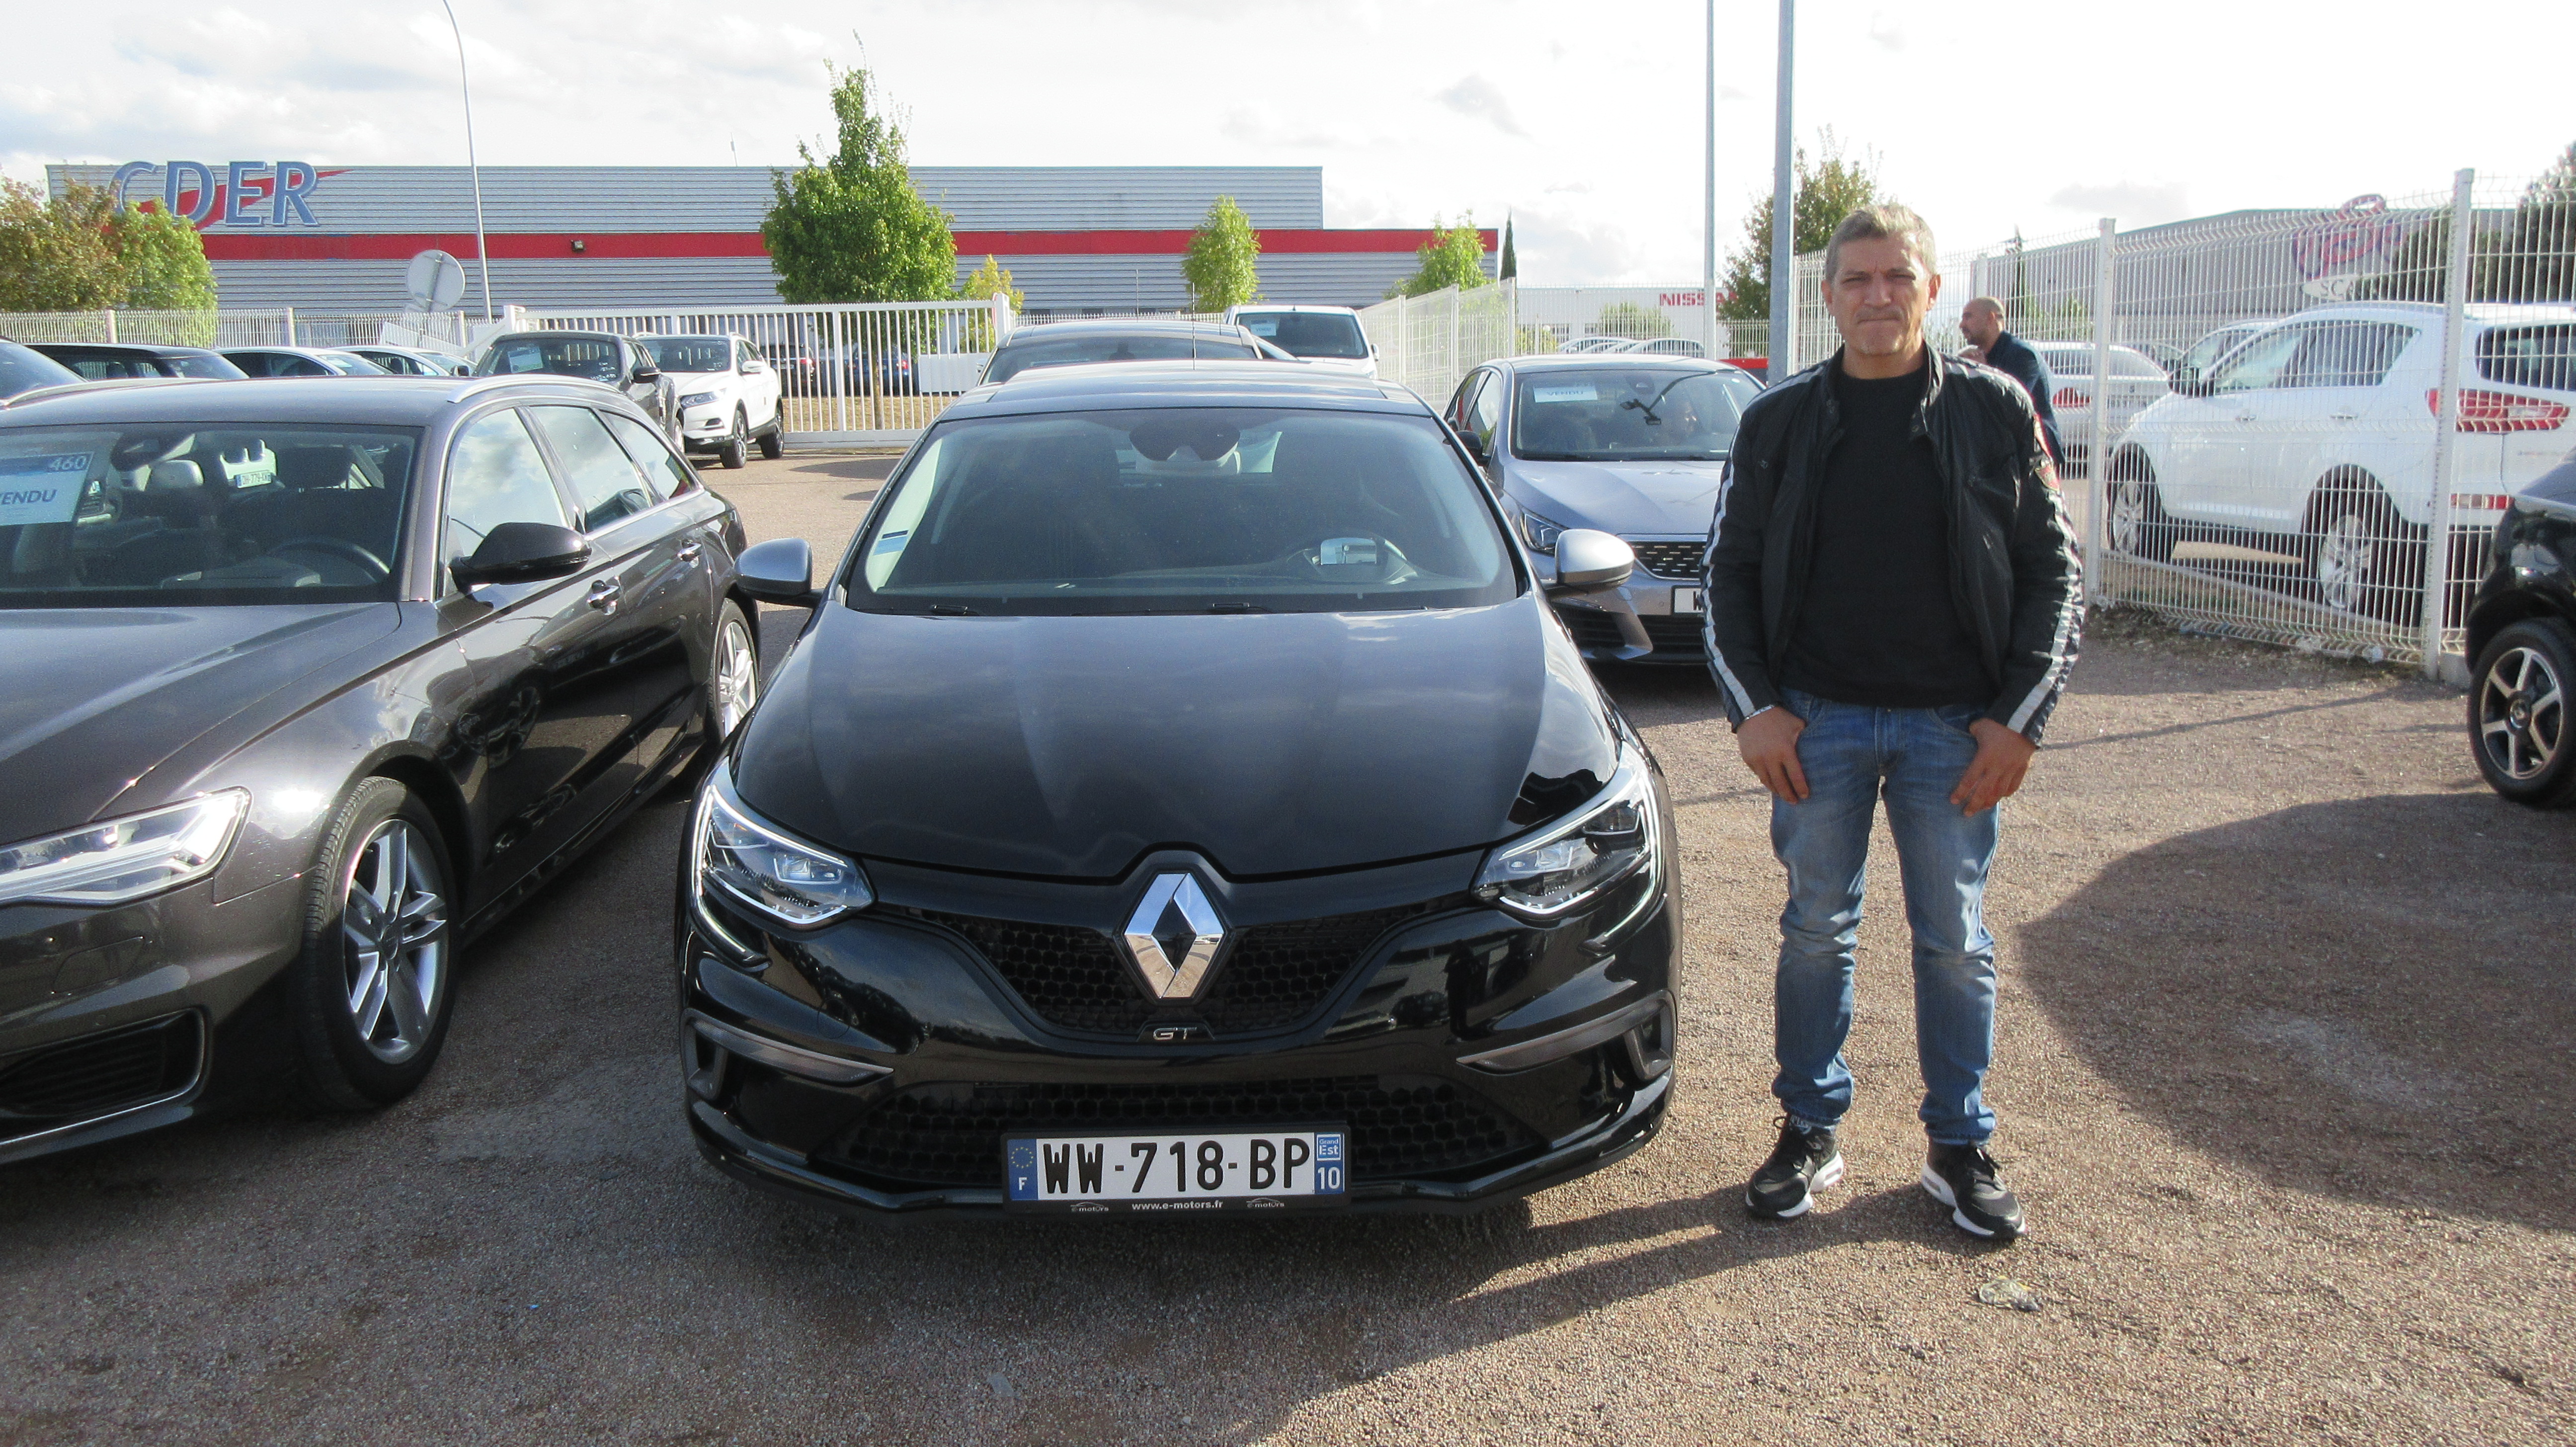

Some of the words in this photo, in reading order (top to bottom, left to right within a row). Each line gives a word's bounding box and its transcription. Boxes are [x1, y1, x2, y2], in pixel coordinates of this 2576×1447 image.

[108, 160, 320, 227] CDER
[50, 456, 87, 470] 460
[0, 489, 58, 504] ENDU
[1153, 1027, 1197, 1041] GT
[1319, 1145, 1339, 1155] Est
[1043, 1138, 1310, 1194] WW-718-BP
[1018, 1177, 1028, 1191] F
[1318, 1167, 1340, 1190] 10
[1131, 1200, 1223, 1210] www.e-motors.fr
